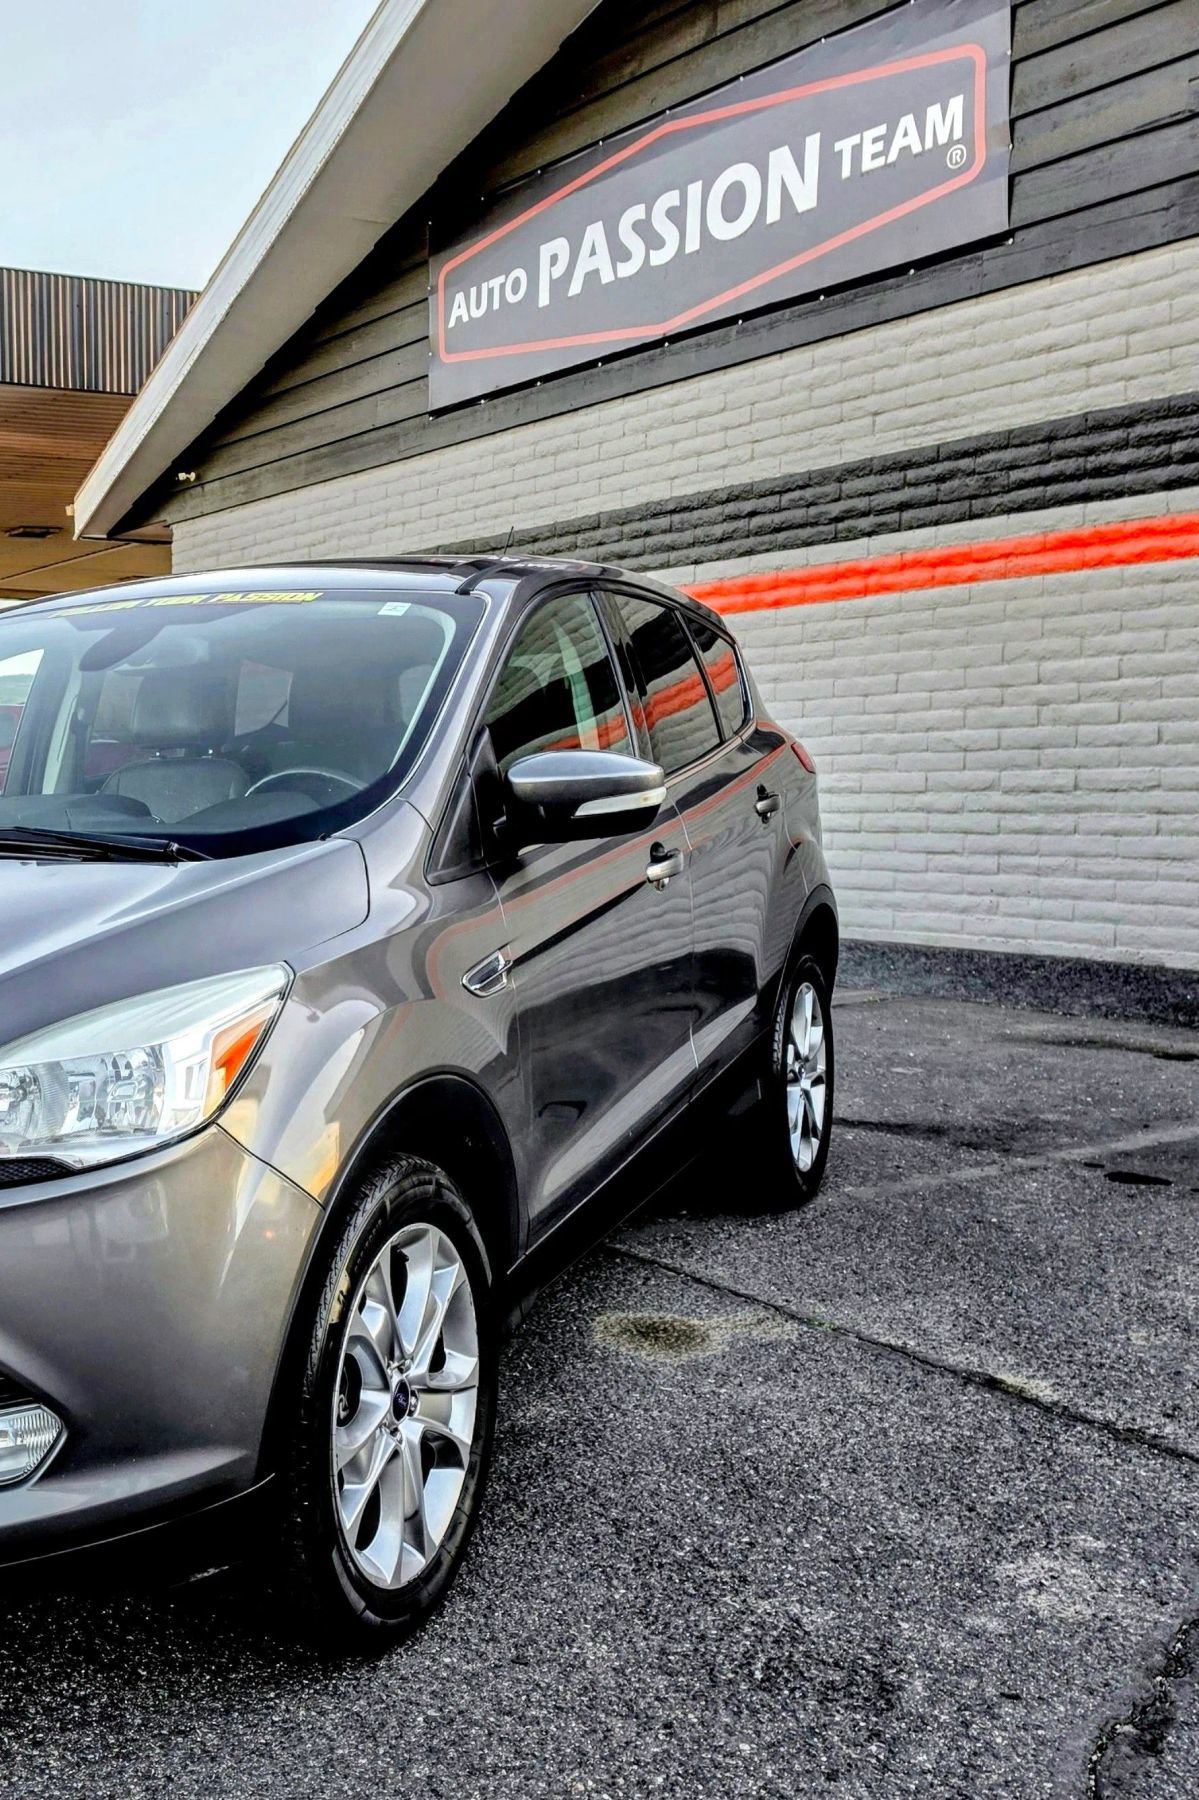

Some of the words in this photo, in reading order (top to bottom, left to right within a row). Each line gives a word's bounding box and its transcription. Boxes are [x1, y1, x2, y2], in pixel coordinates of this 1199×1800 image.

[448, 268, 527, 328] AUTO
[538, 132, 821, 307] PASSION
[834, 94, 964, 180] TEAM
